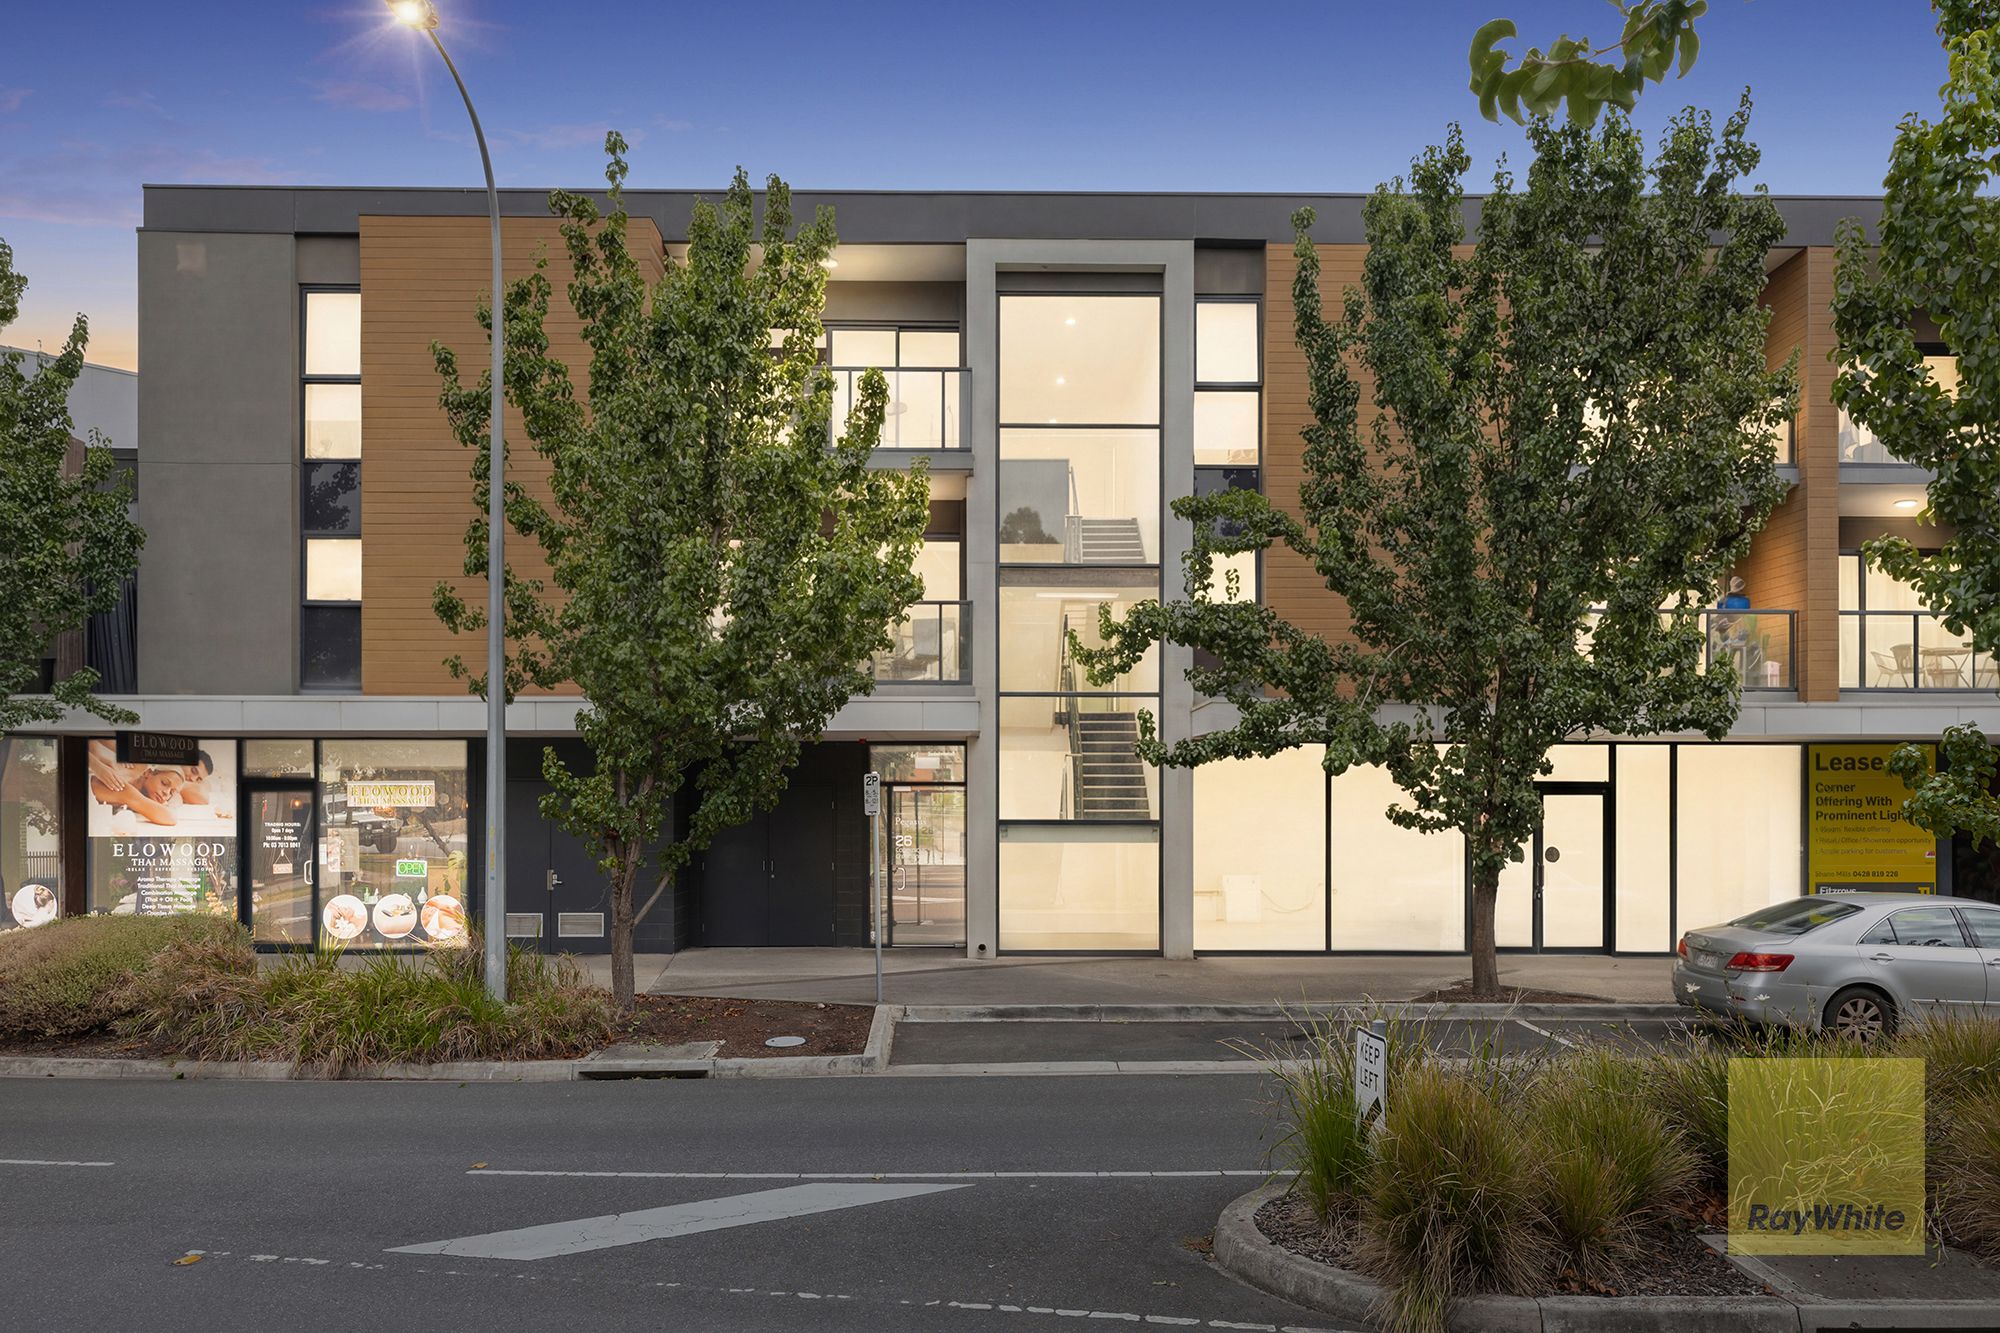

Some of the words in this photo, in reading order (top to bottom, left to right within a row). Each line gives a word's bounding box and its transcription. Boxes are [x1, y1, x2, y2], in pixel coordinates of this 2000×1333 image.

[133, 734, 194, 751] ELOWOOD
[1816, 752, 1884, 771] Lease
[866, 775, 878, 786] 2P
[352, 785, 432, 796] ELOWOOD
[1816, 783, 1856, 792] Corner
[1816, 796, 1862, 808] Offering
[1865, 796, 1892, 806] With
[1816, 810, 1877, 820] Prominent
[1880, 810, 1905, 822] Ligh
[896, 835, 912, 847] 26
[113, 842, 225, 857] ELOWOOD
[132, 858, 156, 866] THAI
[160, 858, 208, 866] MASSAGE
[398, 863, 425, 874] OPEN
[1361, 1041, 1380, 1066] KEEP
[1360, 1066, 1379, 1093] LEFT
